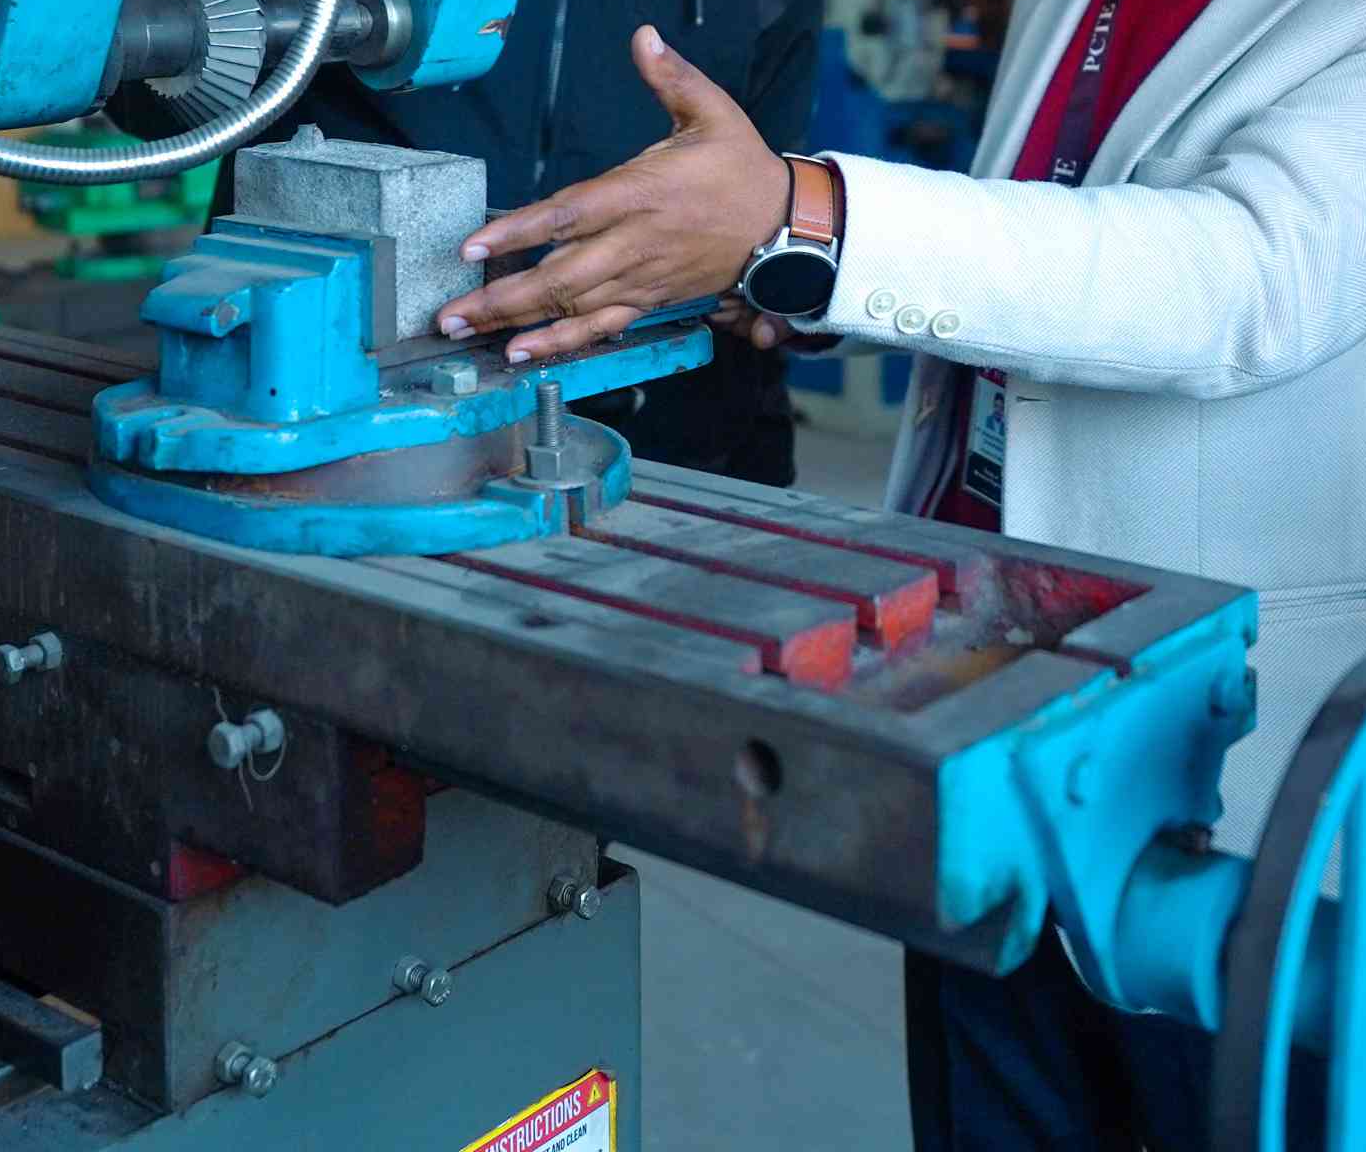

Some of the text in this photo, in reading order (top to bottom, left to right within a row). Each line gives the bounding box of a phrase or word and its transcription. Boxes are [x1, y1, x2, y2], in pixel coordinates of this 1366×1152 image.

[1083, 3, 1116, 71] PCTE
[485, 1091, 582, 1152] STRUCTIONS
[552, 1123, 588, 1152] AND CLEAN
